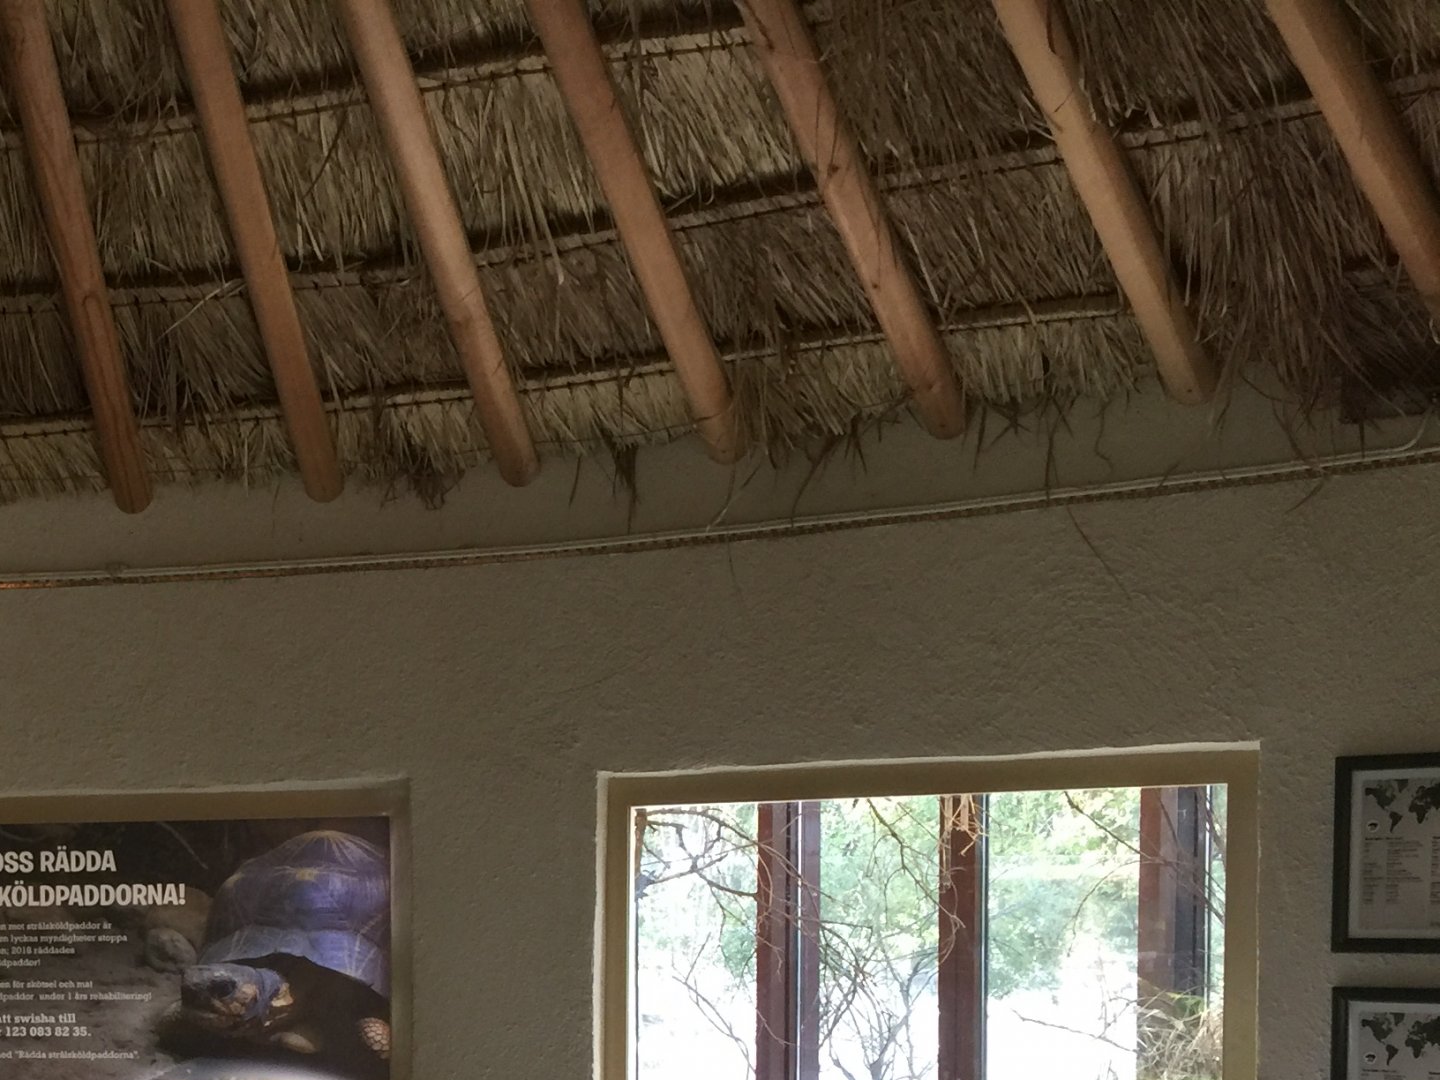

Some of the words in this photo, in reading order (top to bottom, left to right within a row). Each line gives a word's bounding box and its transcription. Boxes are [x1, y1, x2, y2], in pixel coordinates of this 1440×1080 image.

[40, 845, 117, 873] RÄDDA
[14, 1012, 56, 1024] swisha
[58, 1012, 76, 1023] till
[5, 1027, 27, 1037] 123
[72, 1026, 92, 1037] 35.
